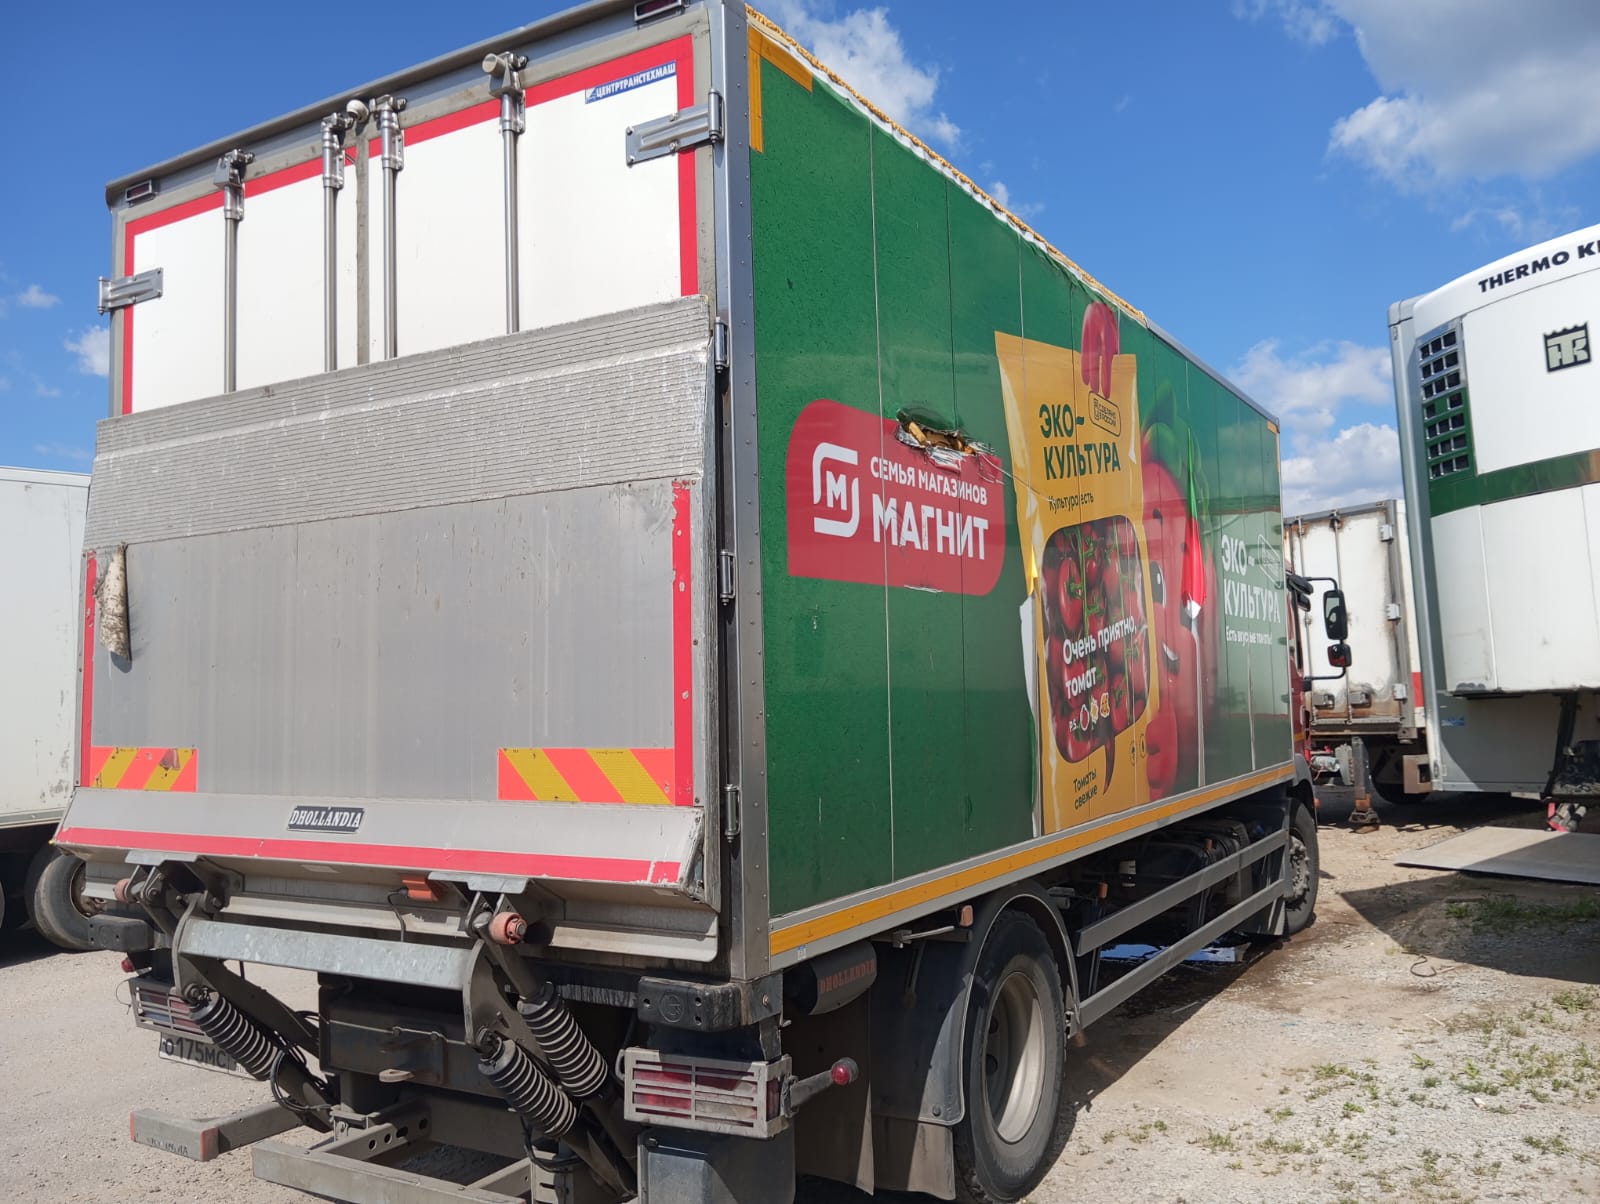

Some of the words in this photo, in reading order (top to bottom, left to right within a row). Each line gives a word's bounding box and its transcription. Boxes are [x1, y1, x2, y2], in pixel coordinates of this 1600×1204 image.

[596, 62, 676, 98] ЦЕНТРТРАНСТЕХМАШ
[1478, 250, 1570, 293] THERMO
[1039, 403, 1085, 439] ЭКО-
[870, 456, 916, 488] СЕМЬЯ
[918, 469, 988, 506] МАГАЗИНОВ
[1043, 441, 1121, 481] КУЛЬТУРА
[872, 493, 989, 561] МАГНИТ
[1222, 534, 1256, 576] ЭКО-
[1223, 578, 1281, 624] КУЛЬТУРА
[1063, 635, 1096, 664] Очень
[1097, 615, 1137, 653] приятно,
[1065, 667, 1097, 700] томат
[1072, 768, 1097, 793] Томаты
[1074, 784, 1098, 811] свежие
[289, 810, 362, 828] DHOLLANDIA
